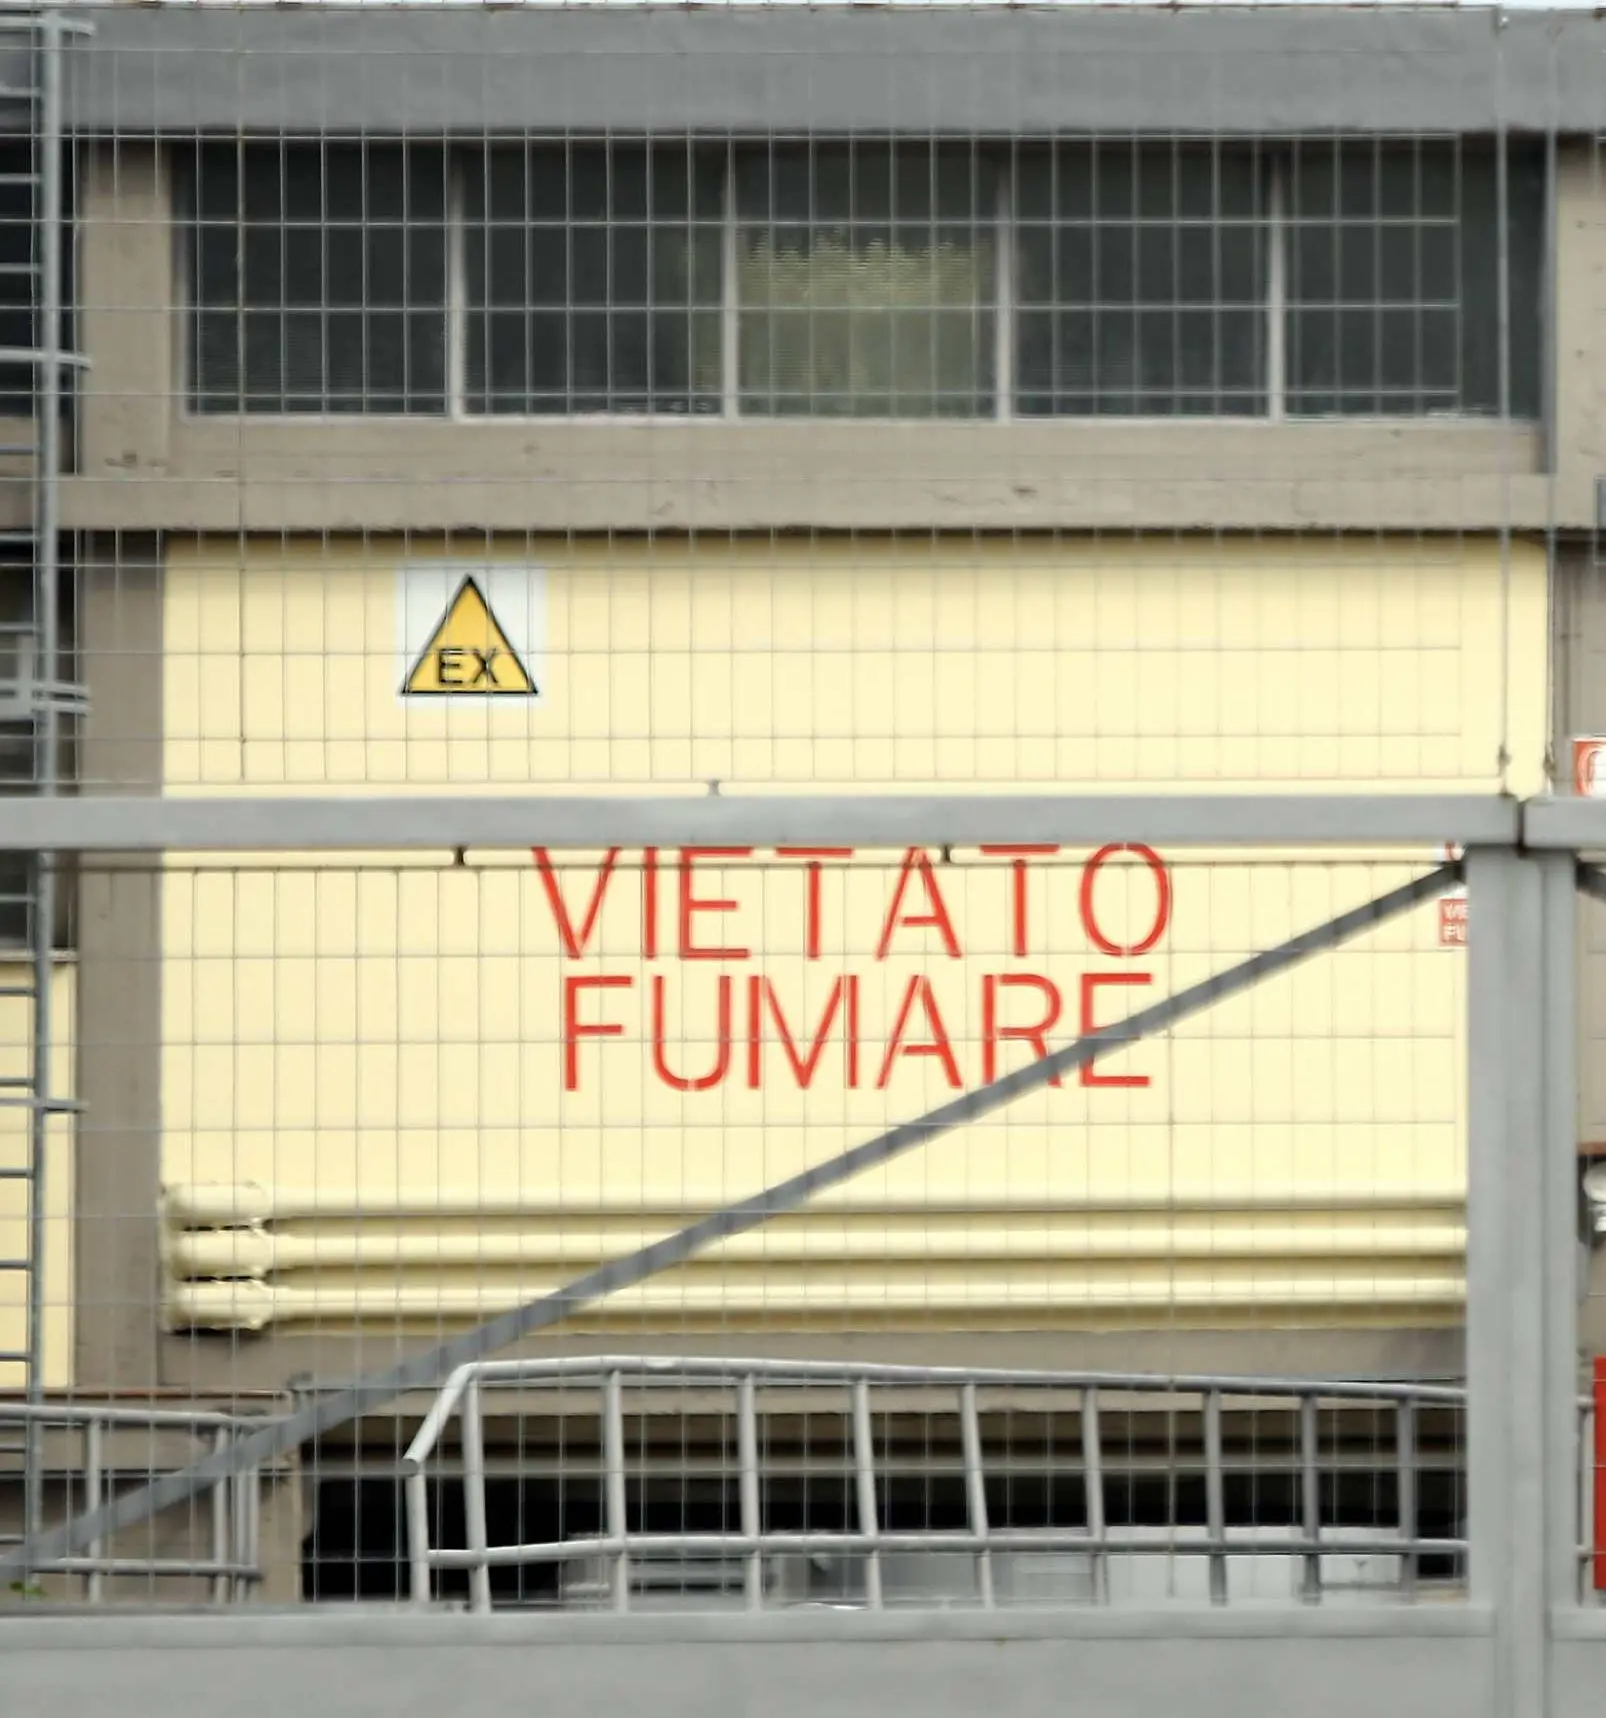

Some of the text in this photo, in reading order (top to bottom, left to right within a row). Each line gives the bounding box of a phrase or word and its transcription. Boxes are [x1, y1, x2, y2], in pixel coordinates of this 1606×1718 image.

[437, 648, 498, 685] EX
[531, 843, 1172, 960] VIETATO
[563, 973, 1153, 1091] FUMARE
